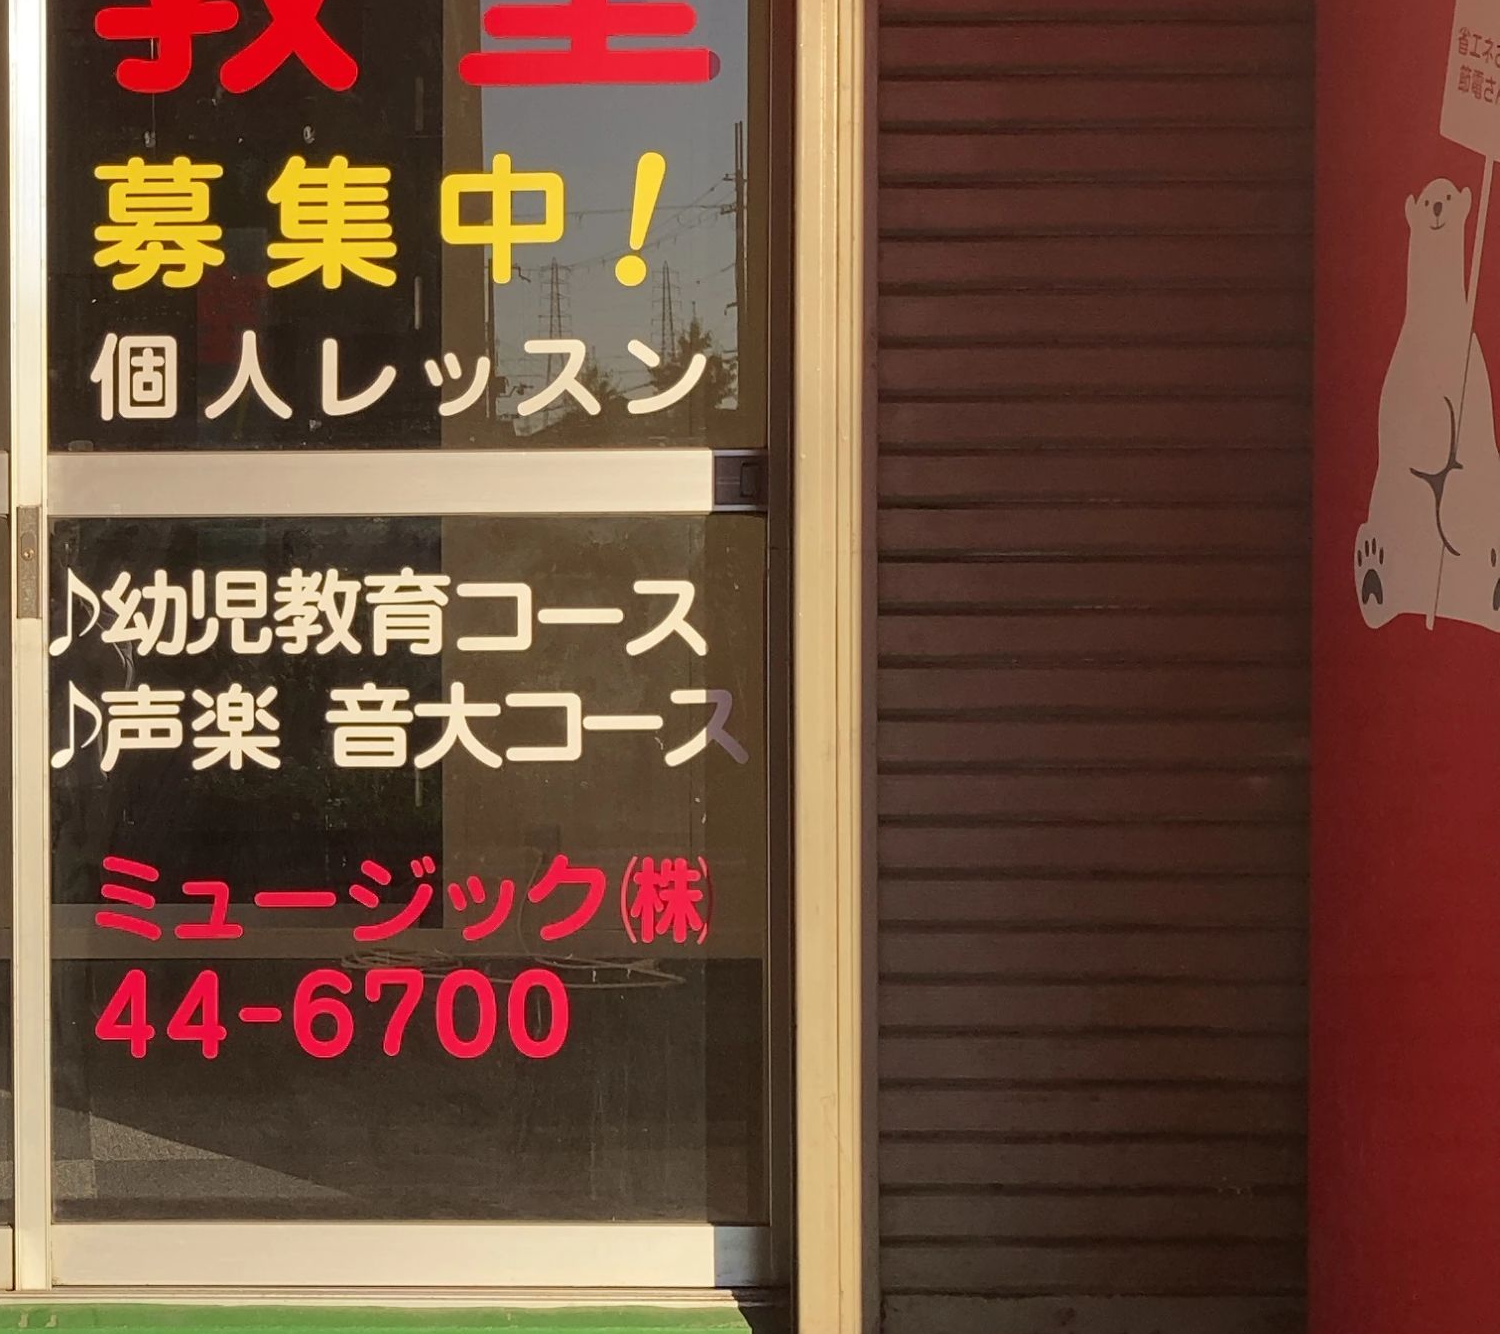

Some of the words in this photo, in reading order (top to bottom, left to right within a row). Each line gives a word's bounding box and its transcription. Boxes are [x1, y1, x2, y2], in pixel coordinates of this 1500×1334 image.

[90, 329, 707, 421] 個人レッスン
[100, 567, 707, 656] 幼児教育コース
[100, 682, 281, 772] 声楽
[325, 681, 749, 769] 音大コース
[94, 968, 570, 1059] 44-6700
